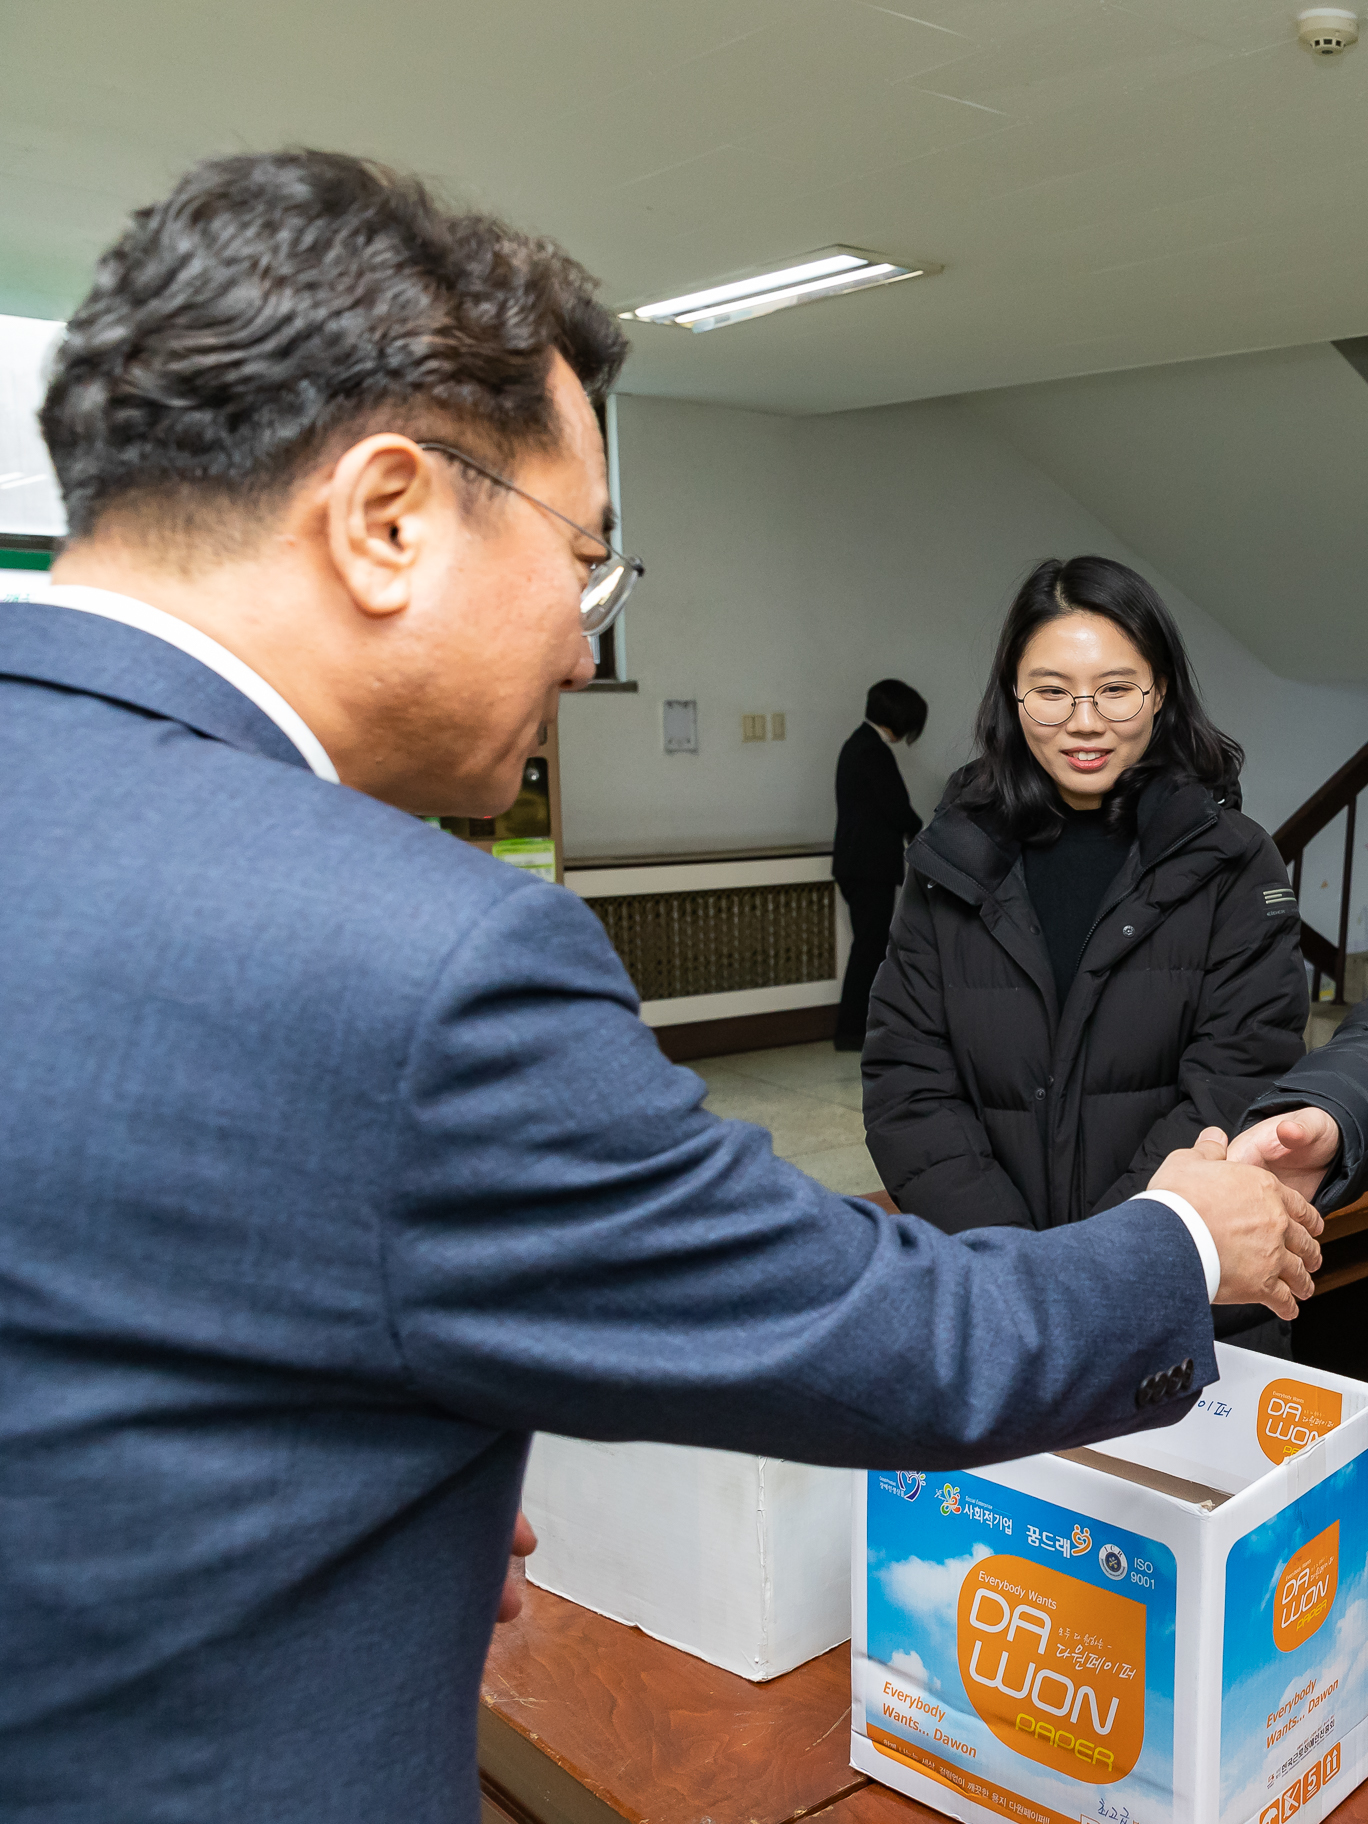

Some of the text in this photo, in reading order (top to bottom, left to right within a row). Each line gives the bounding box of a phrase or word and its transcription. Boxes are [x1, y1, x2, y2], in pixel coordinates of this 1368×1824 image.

[1267, 1397, 1302, 1422] DA
[963, 1503, 1013, 1536] 사회적기업
[1026, 1524, 1071, 1559] 꿈드래
[1130, 1571, 1155, 1590] 9001
[1134, 1557, 1154, 1573] ISO
[978, 1570, 1057, 1610] Everybody Wants
[1281, 1574, 1329, 1629] WON
[1282, 1567, 1310, 1605] DA
[969, 1587, 1052, 1655] DA
[1056, 1643, 1137, 1680] 다원페이퍼
[883, 1681, 946, 1723] Everybody
[969, 1640, 1119, 1735] WON
[1266, 1678, 1317, 1729] Everybody
[882, 1702, 977, 1758] Wants... Dawon
[1266, 1713, 1305, 1749] Wants...
[1308, 1679, 1339, 1714] Dawon
[1015, 1713, 1115, 1772] PAPER
